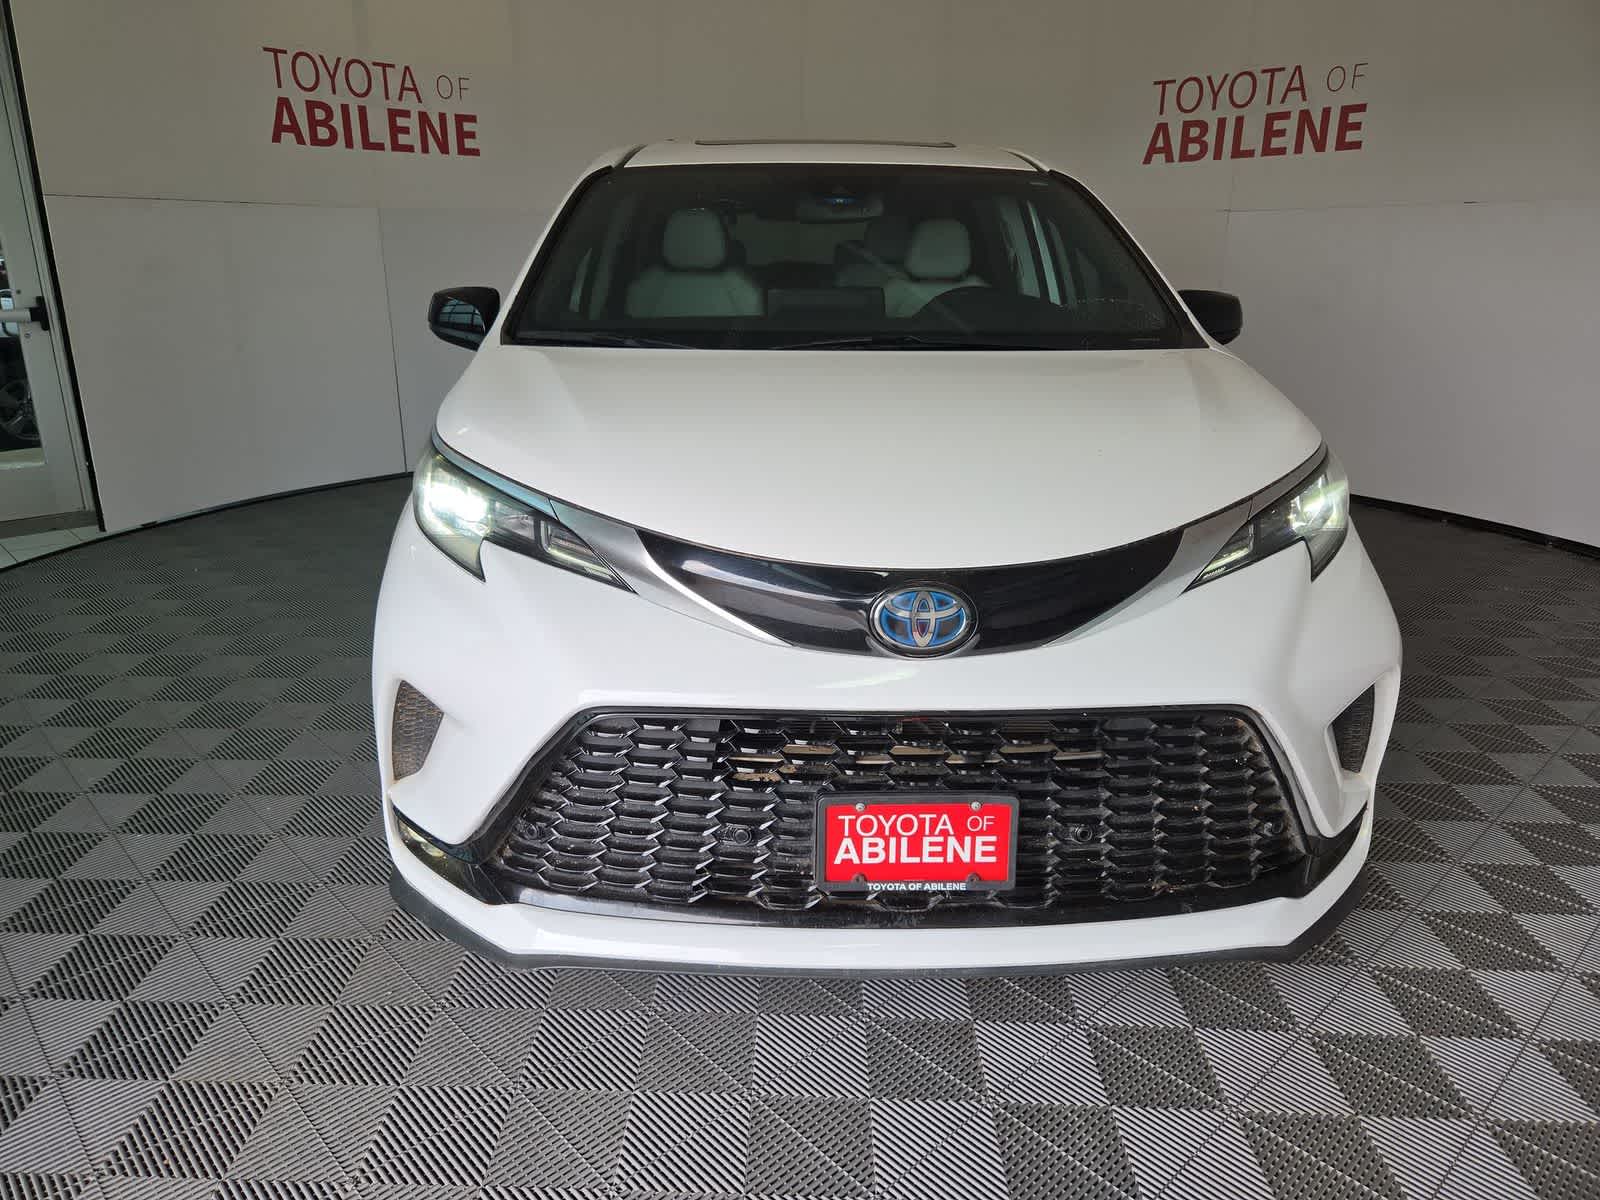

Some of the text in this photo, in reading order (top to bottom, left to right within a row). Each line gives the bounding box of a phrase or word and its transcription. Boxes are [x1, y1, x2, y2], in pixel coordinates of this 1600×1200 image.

[262, 46, 470, 104] TOYOTA OF
[1152, 62, 1369, 116] TOYOTA OF
[271, 96, 481, 157] ABILENE
[1142, 103, 1368, 165] ABILENE
[833, 835, 998, 865] ABILENE
[838, 813, 995, 837] TOYOTA OF
[867, 882, 967, 891] TOYOTA OF ABILENE
